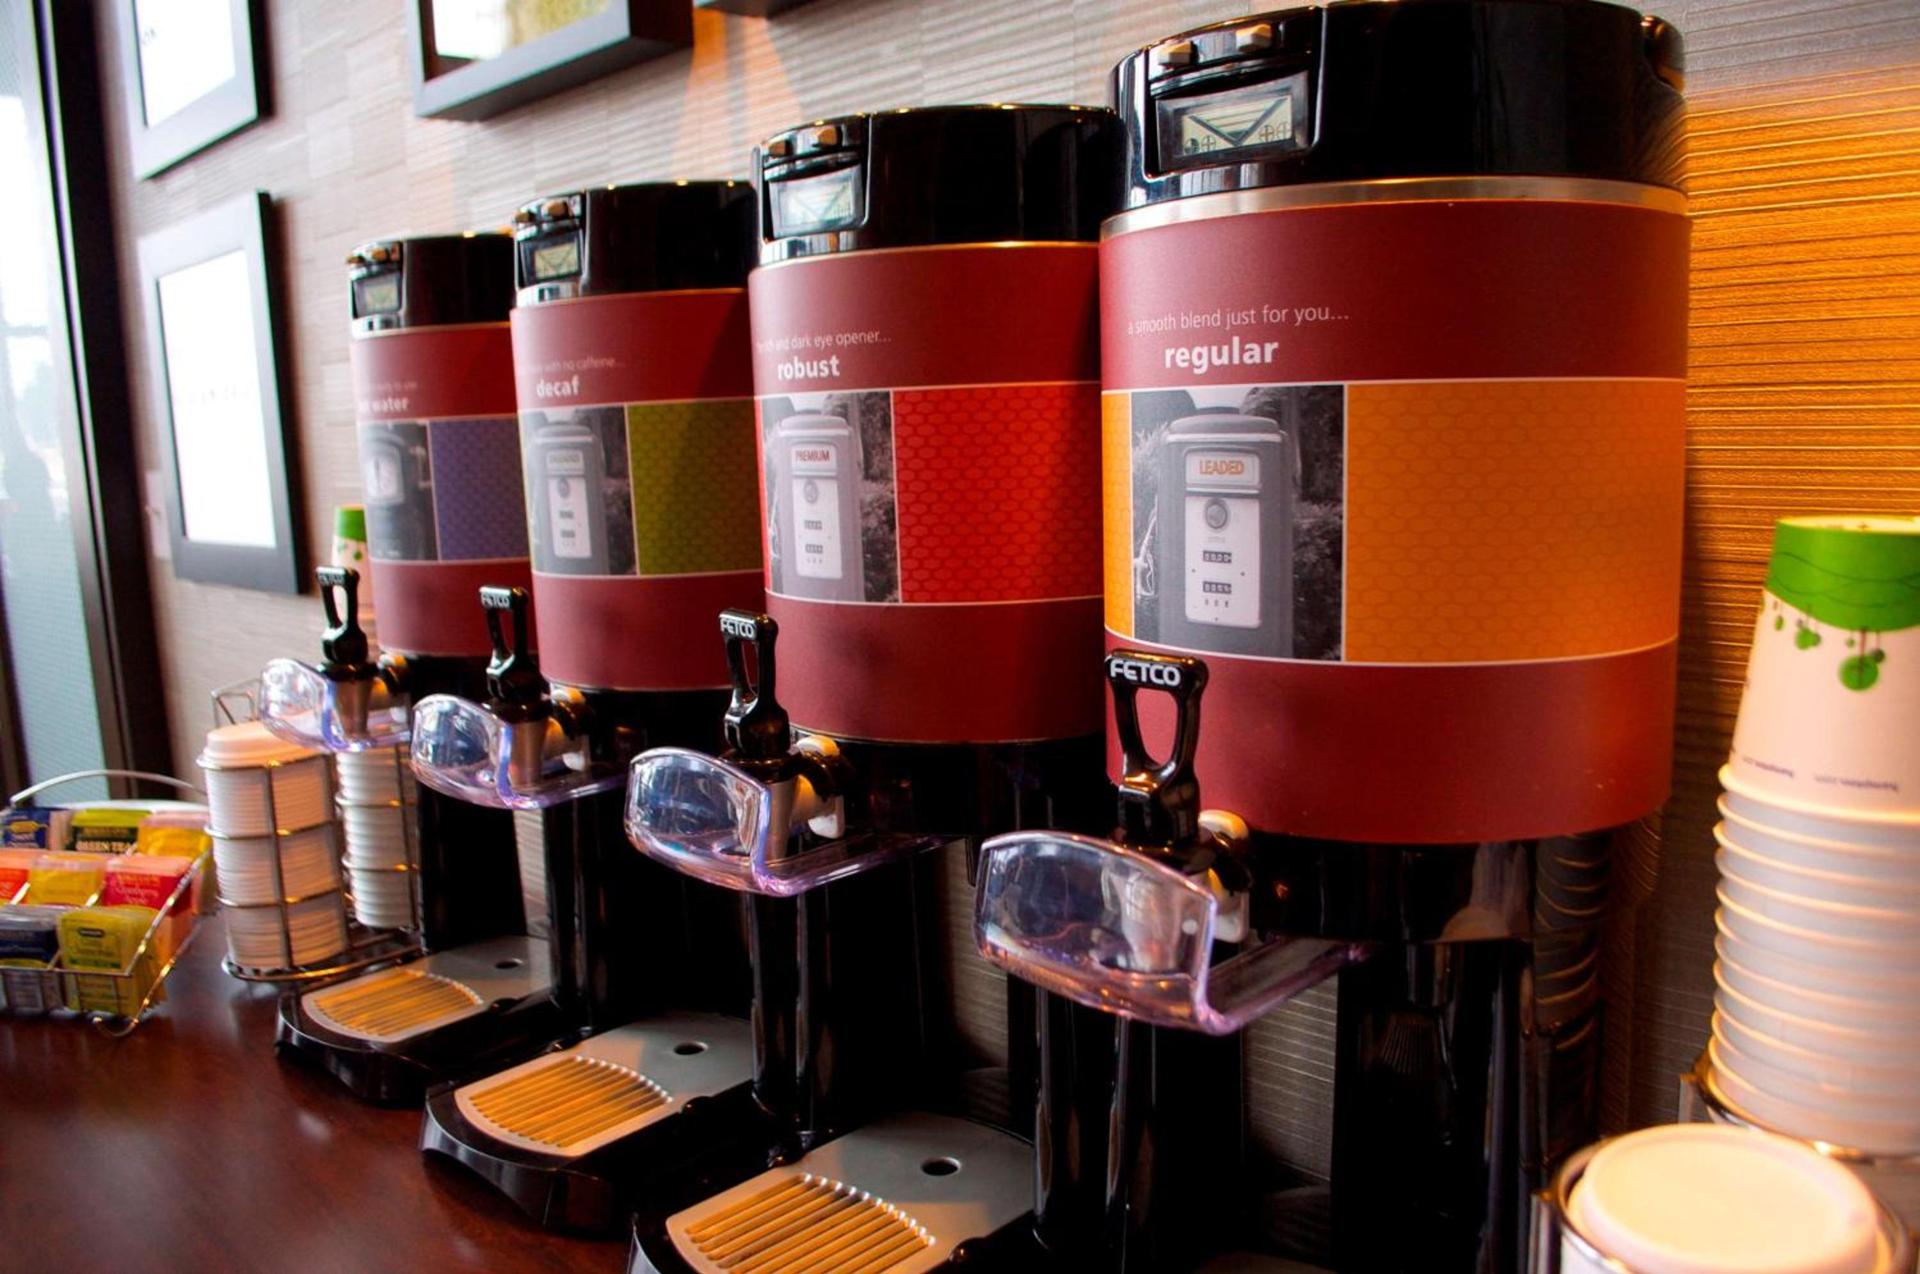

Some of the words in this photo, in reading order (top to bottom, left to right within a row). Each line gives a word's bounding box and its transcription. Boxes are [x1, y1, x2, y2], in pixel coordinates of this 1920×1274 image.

[1134, 312, 1177, 337] smooth
[1179, 308, 1222, 329] blend
[1224, 309, 1257, 331] just
[1262, 304, 1290, 323] for
[791, 334, 812, 350] dark
[814, 334, 833, 351] eye
[1163, 336, 1280, 375] regular
[777, 354, 841, 381] robust
[536, 374, 580, 398] decaf
[372, 396, 409, 413] water
[795, 449, 831, 462] PREMIUM
[1199, 459, 1245, 476] LEADED
[720, 617, 754, 638] FETCO
[1110, 659, 1181, 687] FETCO
